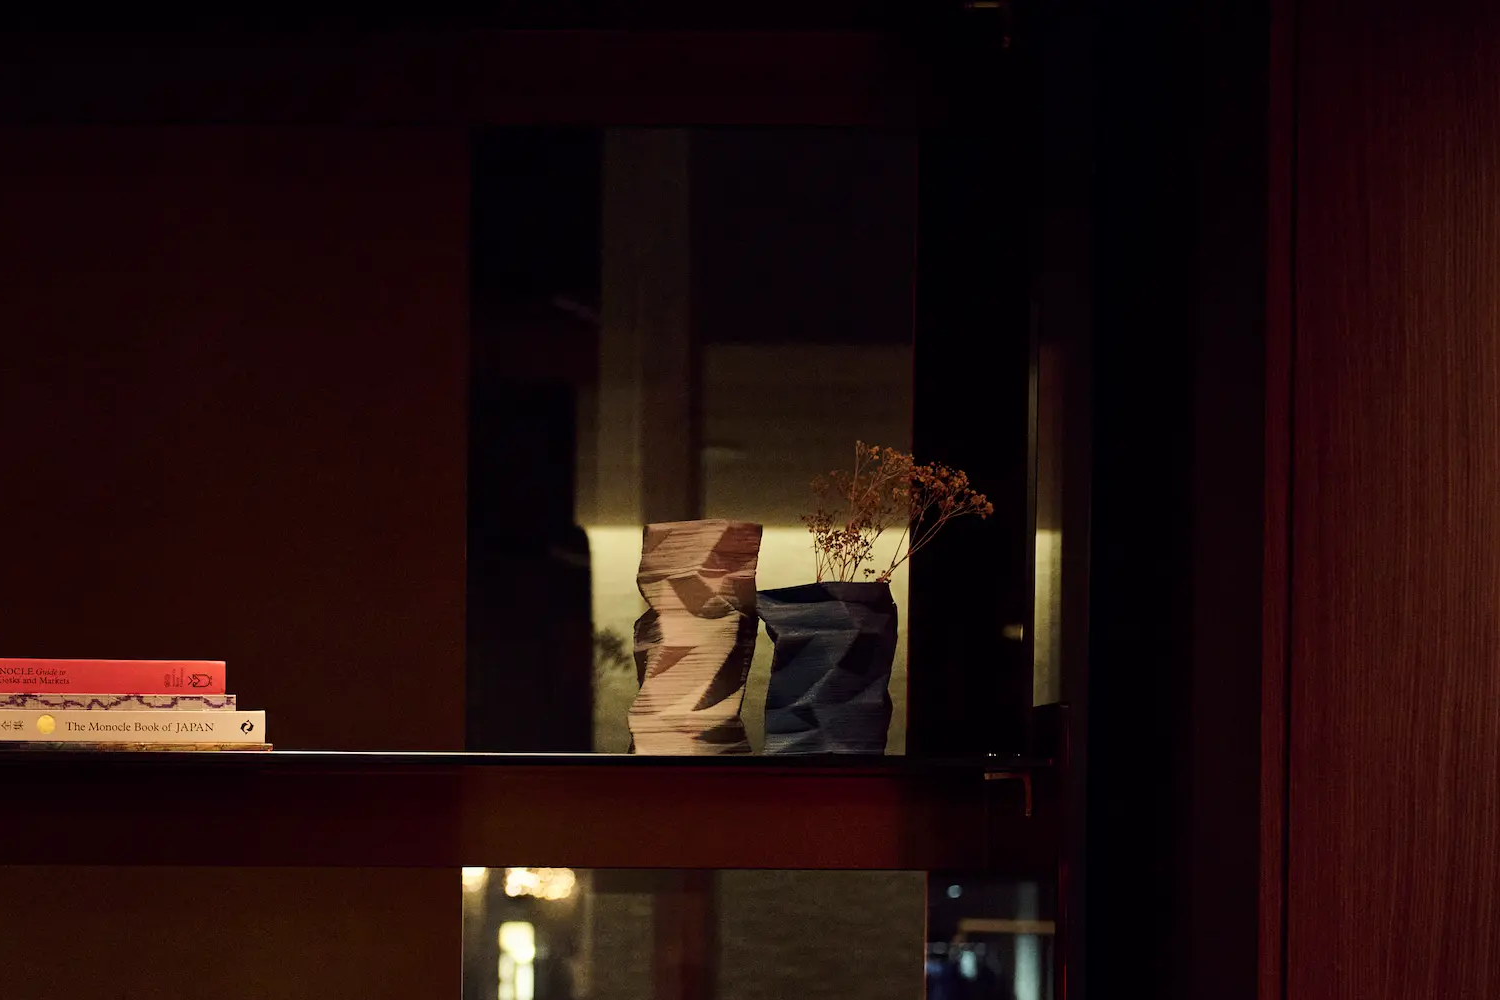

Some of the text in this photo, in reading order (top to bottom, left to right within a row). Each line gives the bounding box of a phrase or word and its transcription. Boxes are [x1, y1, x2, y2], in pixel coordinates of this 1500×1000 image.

[35, 668, 57, 676] Guide
[39, 677, 70, 685] Markets
[65, 722, 215, 733] The Monocle Book of JAPAN
